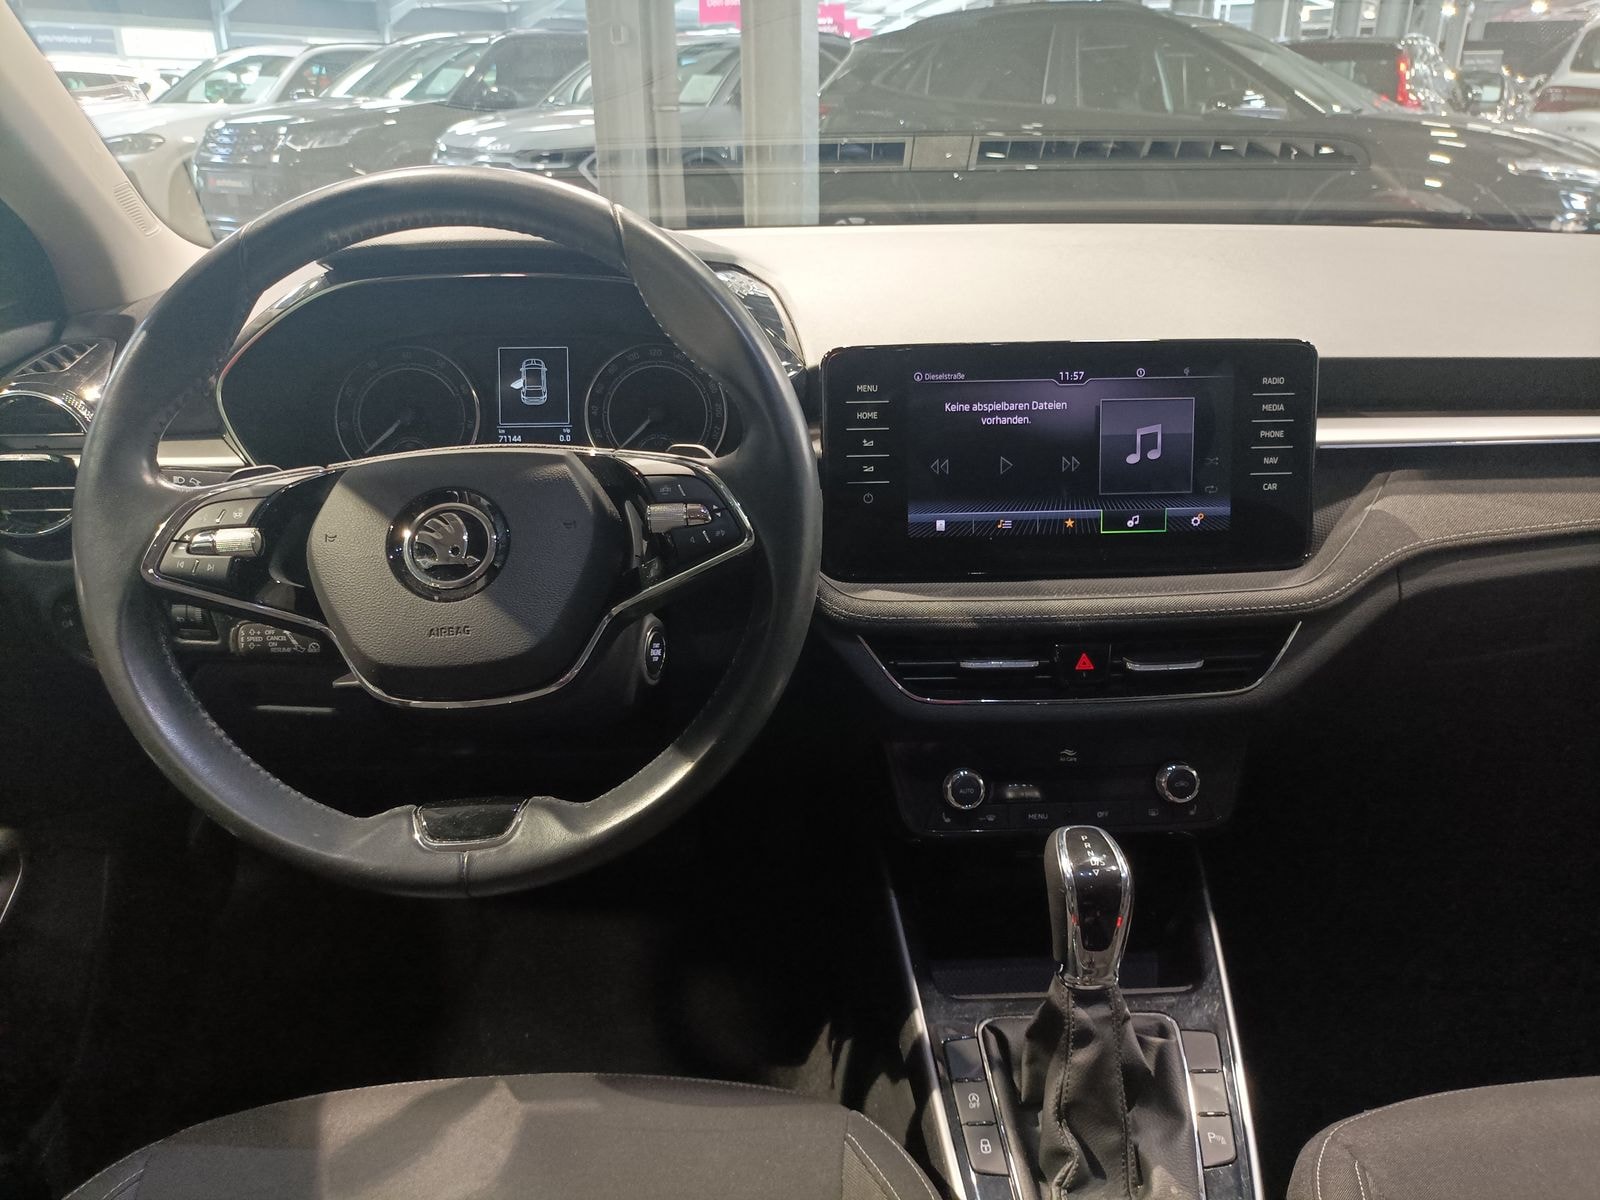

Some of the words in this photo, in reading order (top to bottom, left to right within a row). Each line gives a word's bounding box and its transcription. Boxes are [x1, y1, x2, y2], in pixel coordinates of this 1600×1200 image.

[924, 372, 965, 380] Dieselstraße
[1059, 371, 1084, 381] 11:57
[1262, 376, 1285, 385] RADIO
[856, 384, 878, 393] MENU
[944, 402, 970, 412] Keine
[972, 401, 1029, 413] abspielbaren
[1031, 400, 1067, 410] Dateien
[1262, 403, 1285, 412] MEDIA
[856, 411, 878, 420] HOME
[981, 415, 1031, 425] vorhanden.
[559, 434, 571, 442] 0.0
[1260, 430, 1284, 438] PHONE
[498, 435, 522, 443] 71144
[1263, 456, 1279, 465] NAV
[1263, 482, 1278, 491] CAR
[428, 625, 472, 638] AIRBAG
[1096, 810, 1109, 818] OFF
